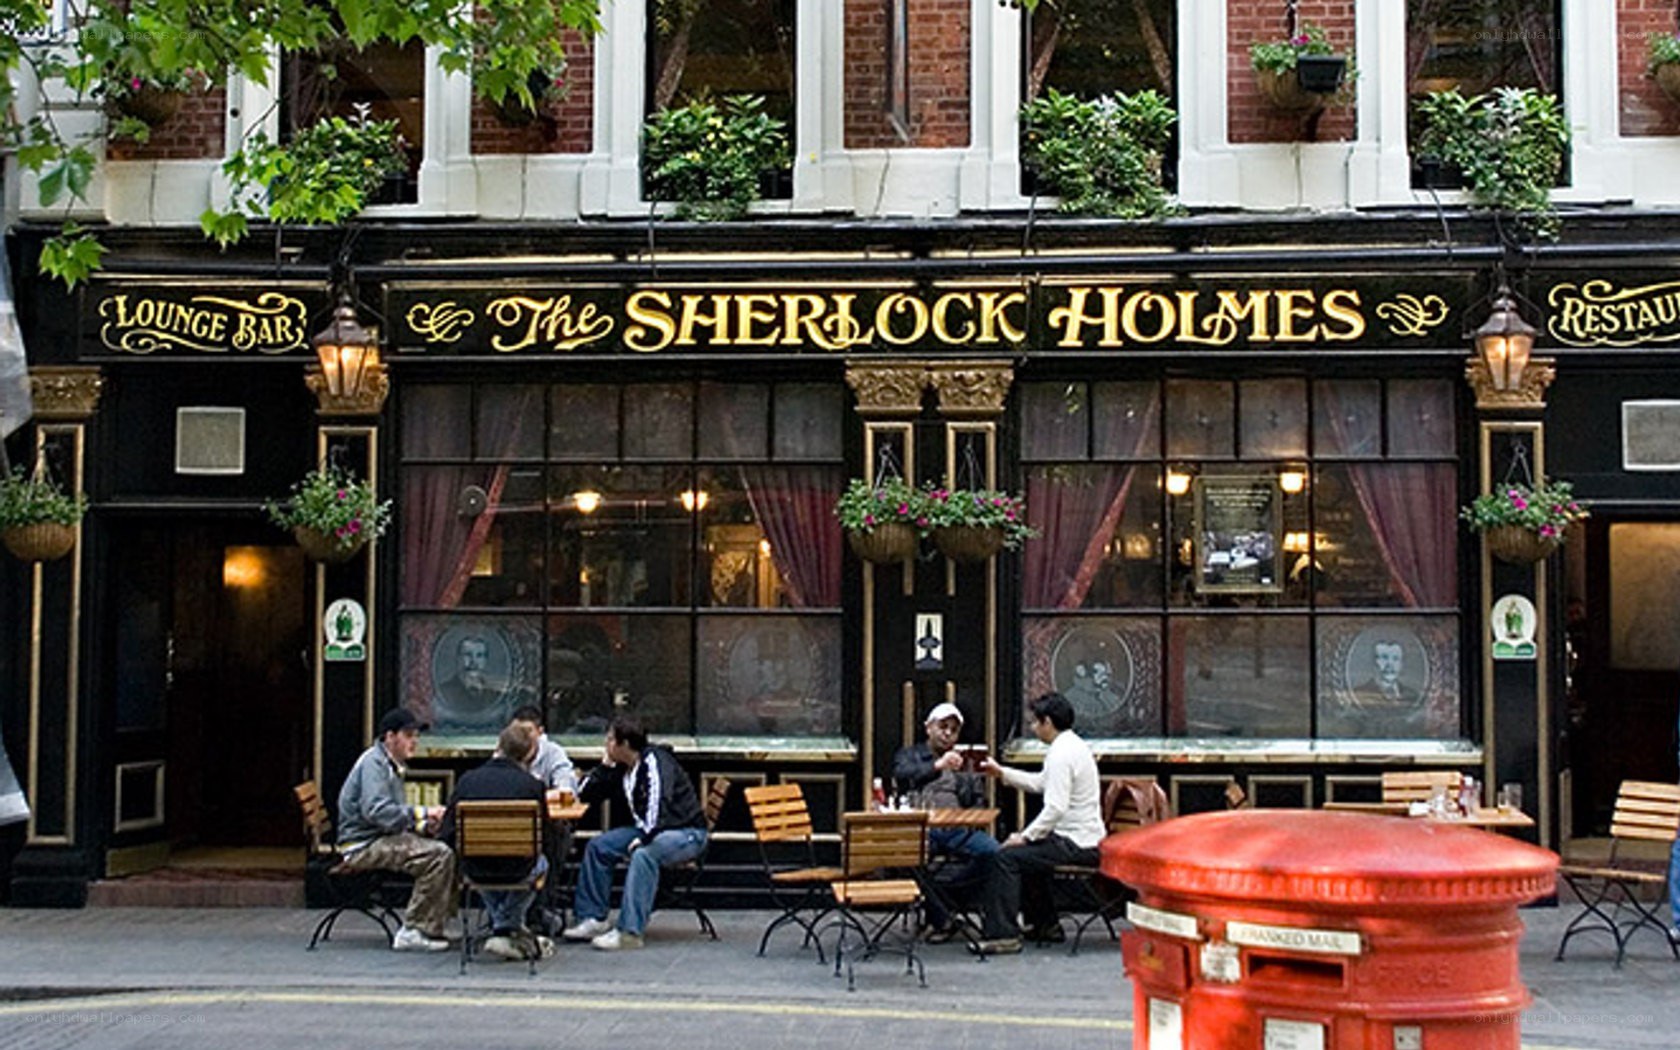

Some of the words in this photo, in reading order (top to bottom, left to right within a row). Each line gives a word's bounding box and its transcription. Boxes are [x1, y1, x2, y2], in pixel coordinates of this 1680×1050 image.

[115, 295, 228, 342] LOUNGE
[232, 313, 295, 350] BAR
[486, 295, 614, 352] The
[623, 289, 1027, 352] SHERLOCK
[1048, 286, 1366, 347] HOLMES
